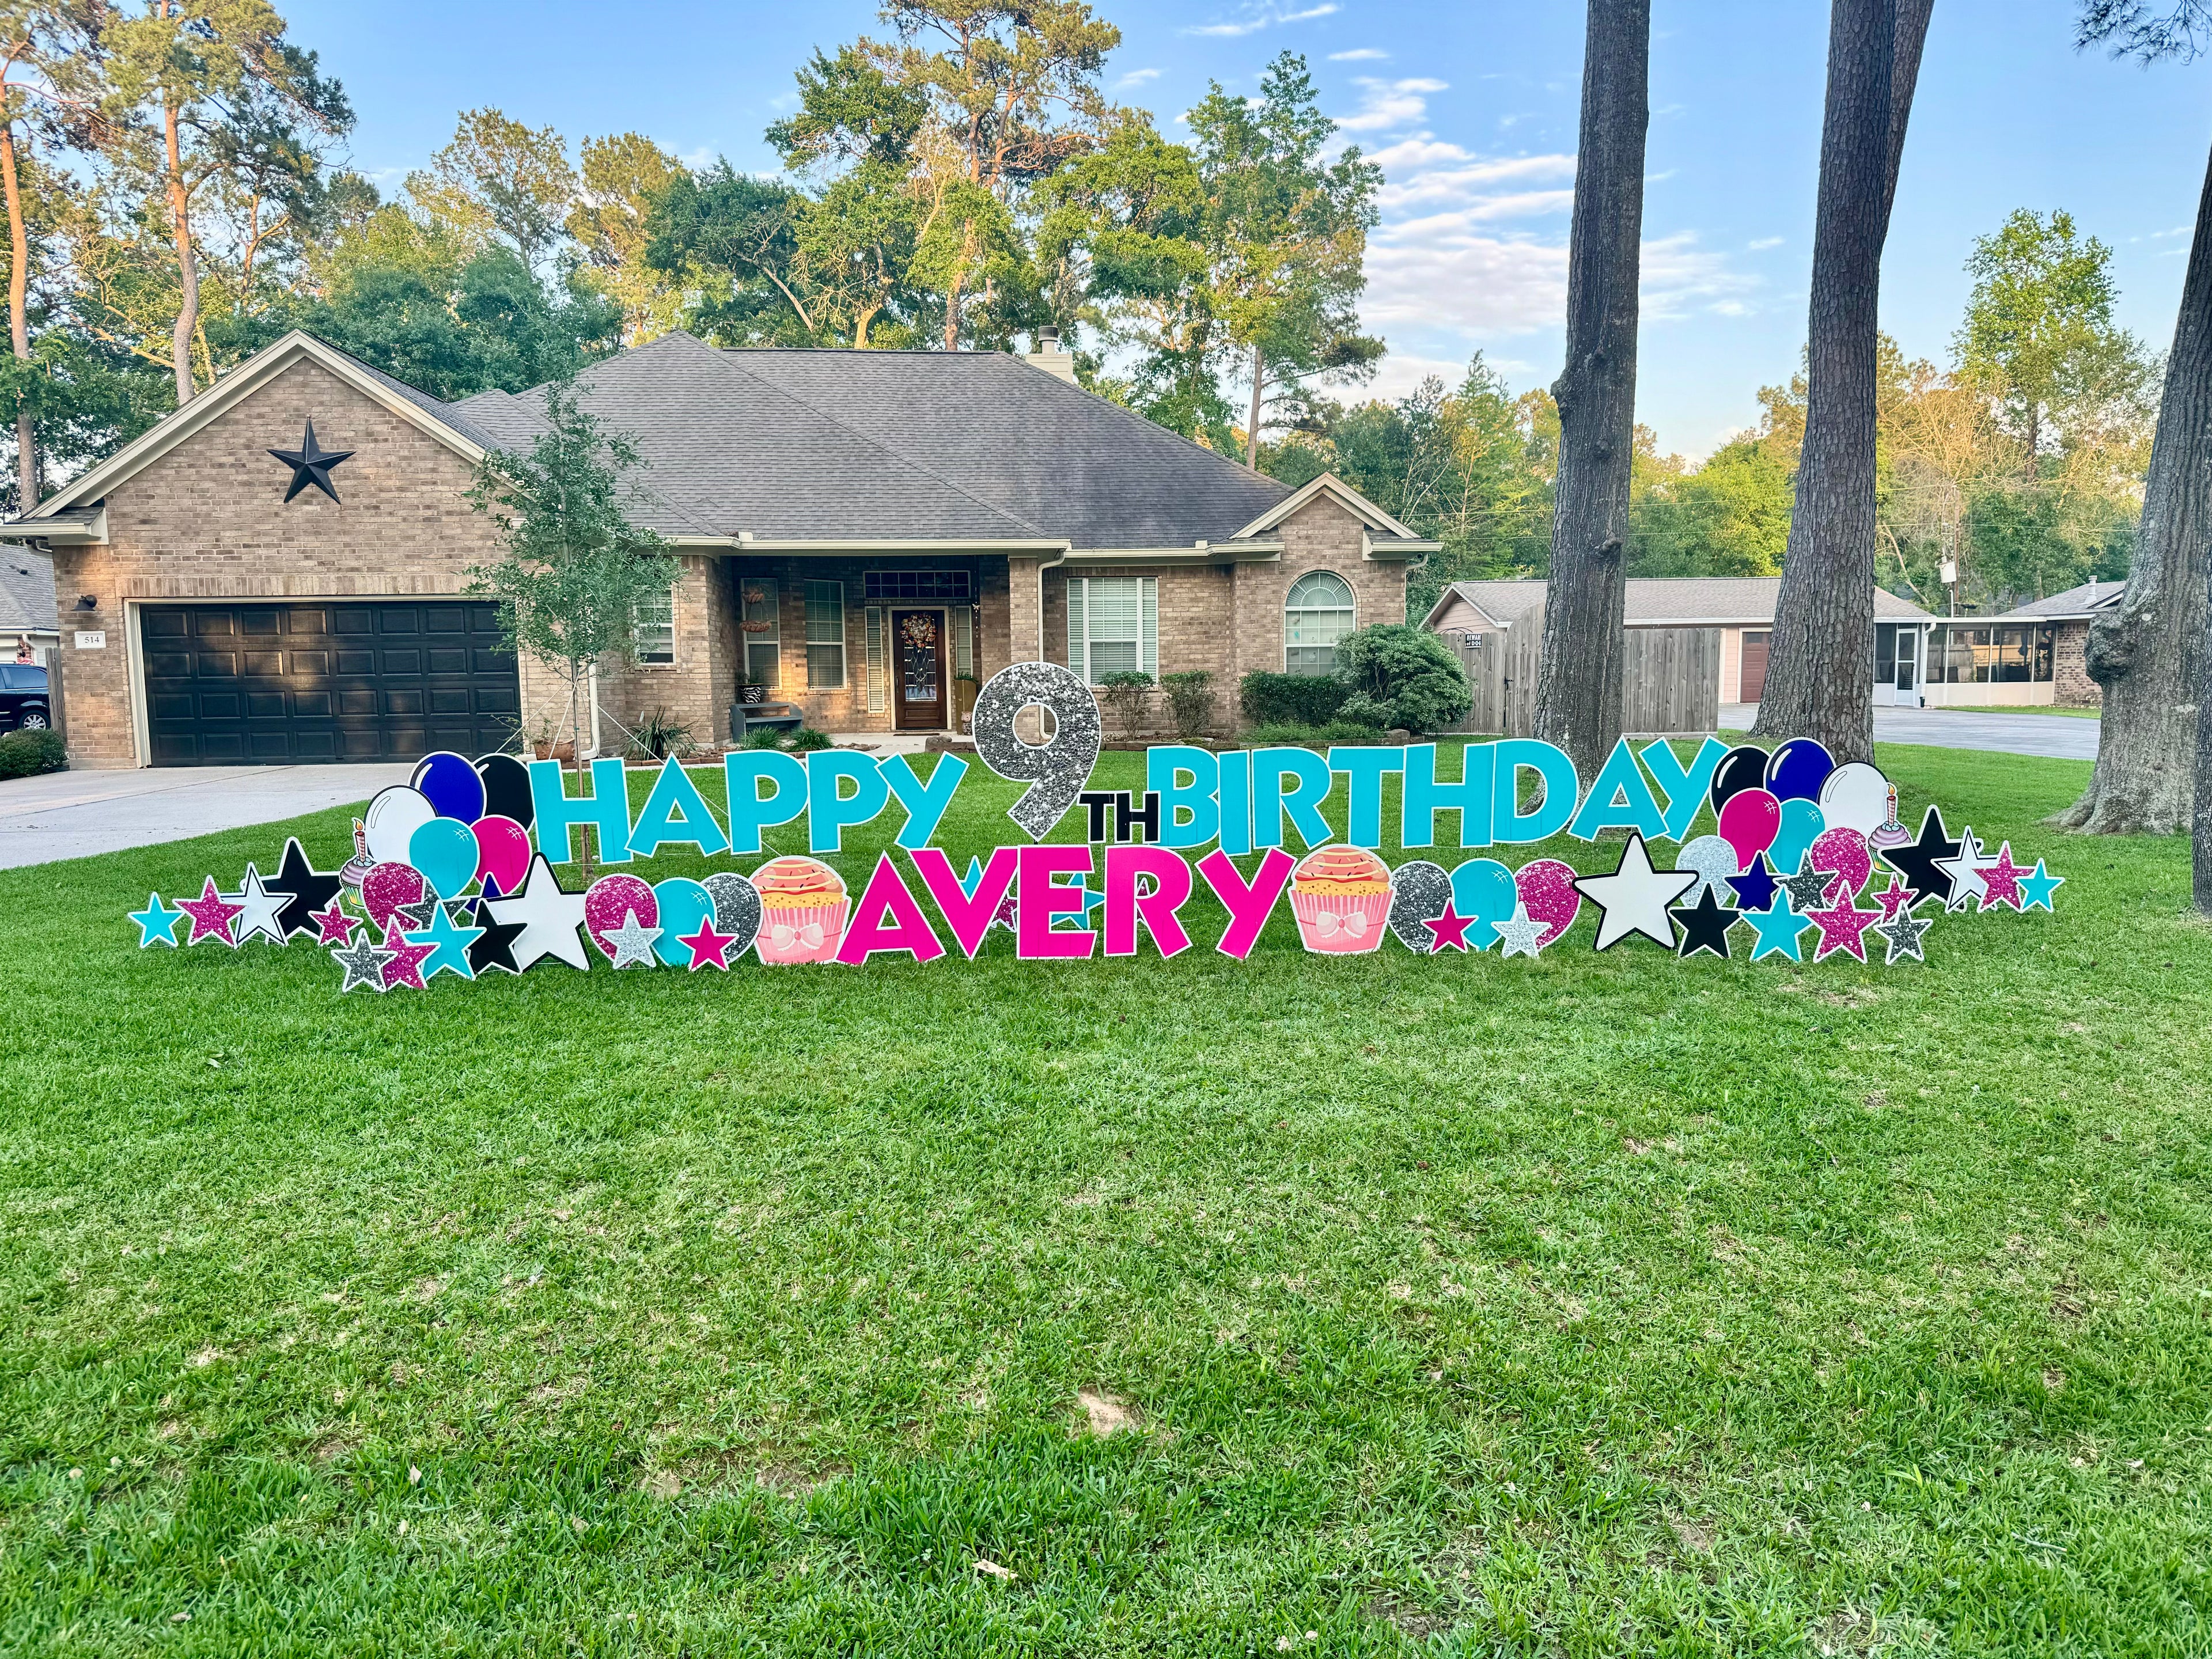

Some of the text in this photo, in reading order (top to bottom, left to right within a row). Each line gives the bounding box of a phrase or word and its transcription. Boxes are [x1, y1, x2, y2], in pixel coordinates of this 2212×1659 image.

[527, 749, 969, 865] HAPPY
[1147, 734, 1732, 857] BIRTHDAY
[836, 844, 1297, 965] AVERY
